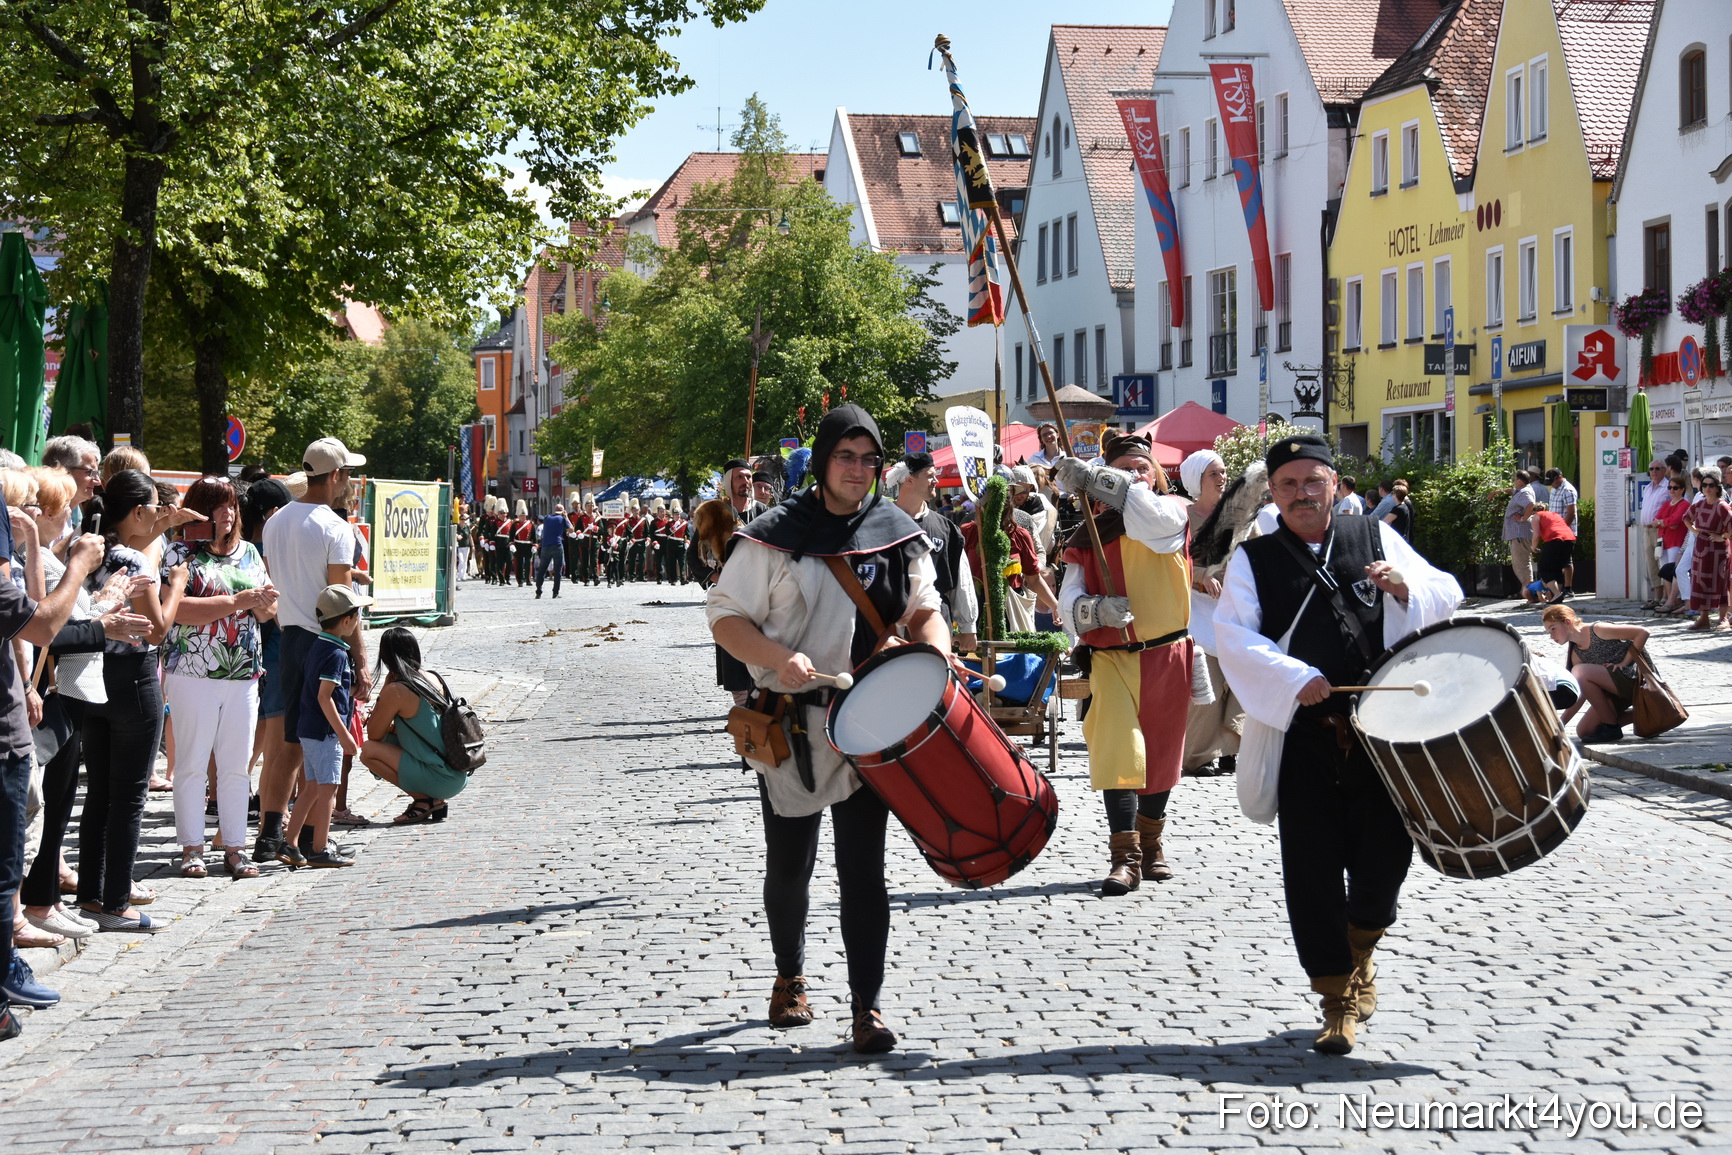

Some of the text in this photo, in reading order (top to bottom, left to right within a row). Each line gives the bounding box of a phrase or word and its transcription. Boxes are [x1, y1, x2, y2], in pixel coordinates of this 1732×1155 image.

[1220, 67, 1249, 123] K&L
[1241, 68, 1254, 123] RUPPERT
[1388, 217, 1466, 258] HOTEL Lehmeier
[1446, 313, 1452, 345] P
[1427, 363, 1468, 371] TAIUN
[1493, 343, 1500, 375] P
[1506, 345, 1537, 367] TAIFUN
[1386, 378, 1431, 400] Restaurant
[1655, 408, 1675, 419] APOTHEKE
[1073, 444, 1100, 455] VOLKSFEST
[525, 480, 534, 490] T
[384, 497, 430, 539] BOGNER
